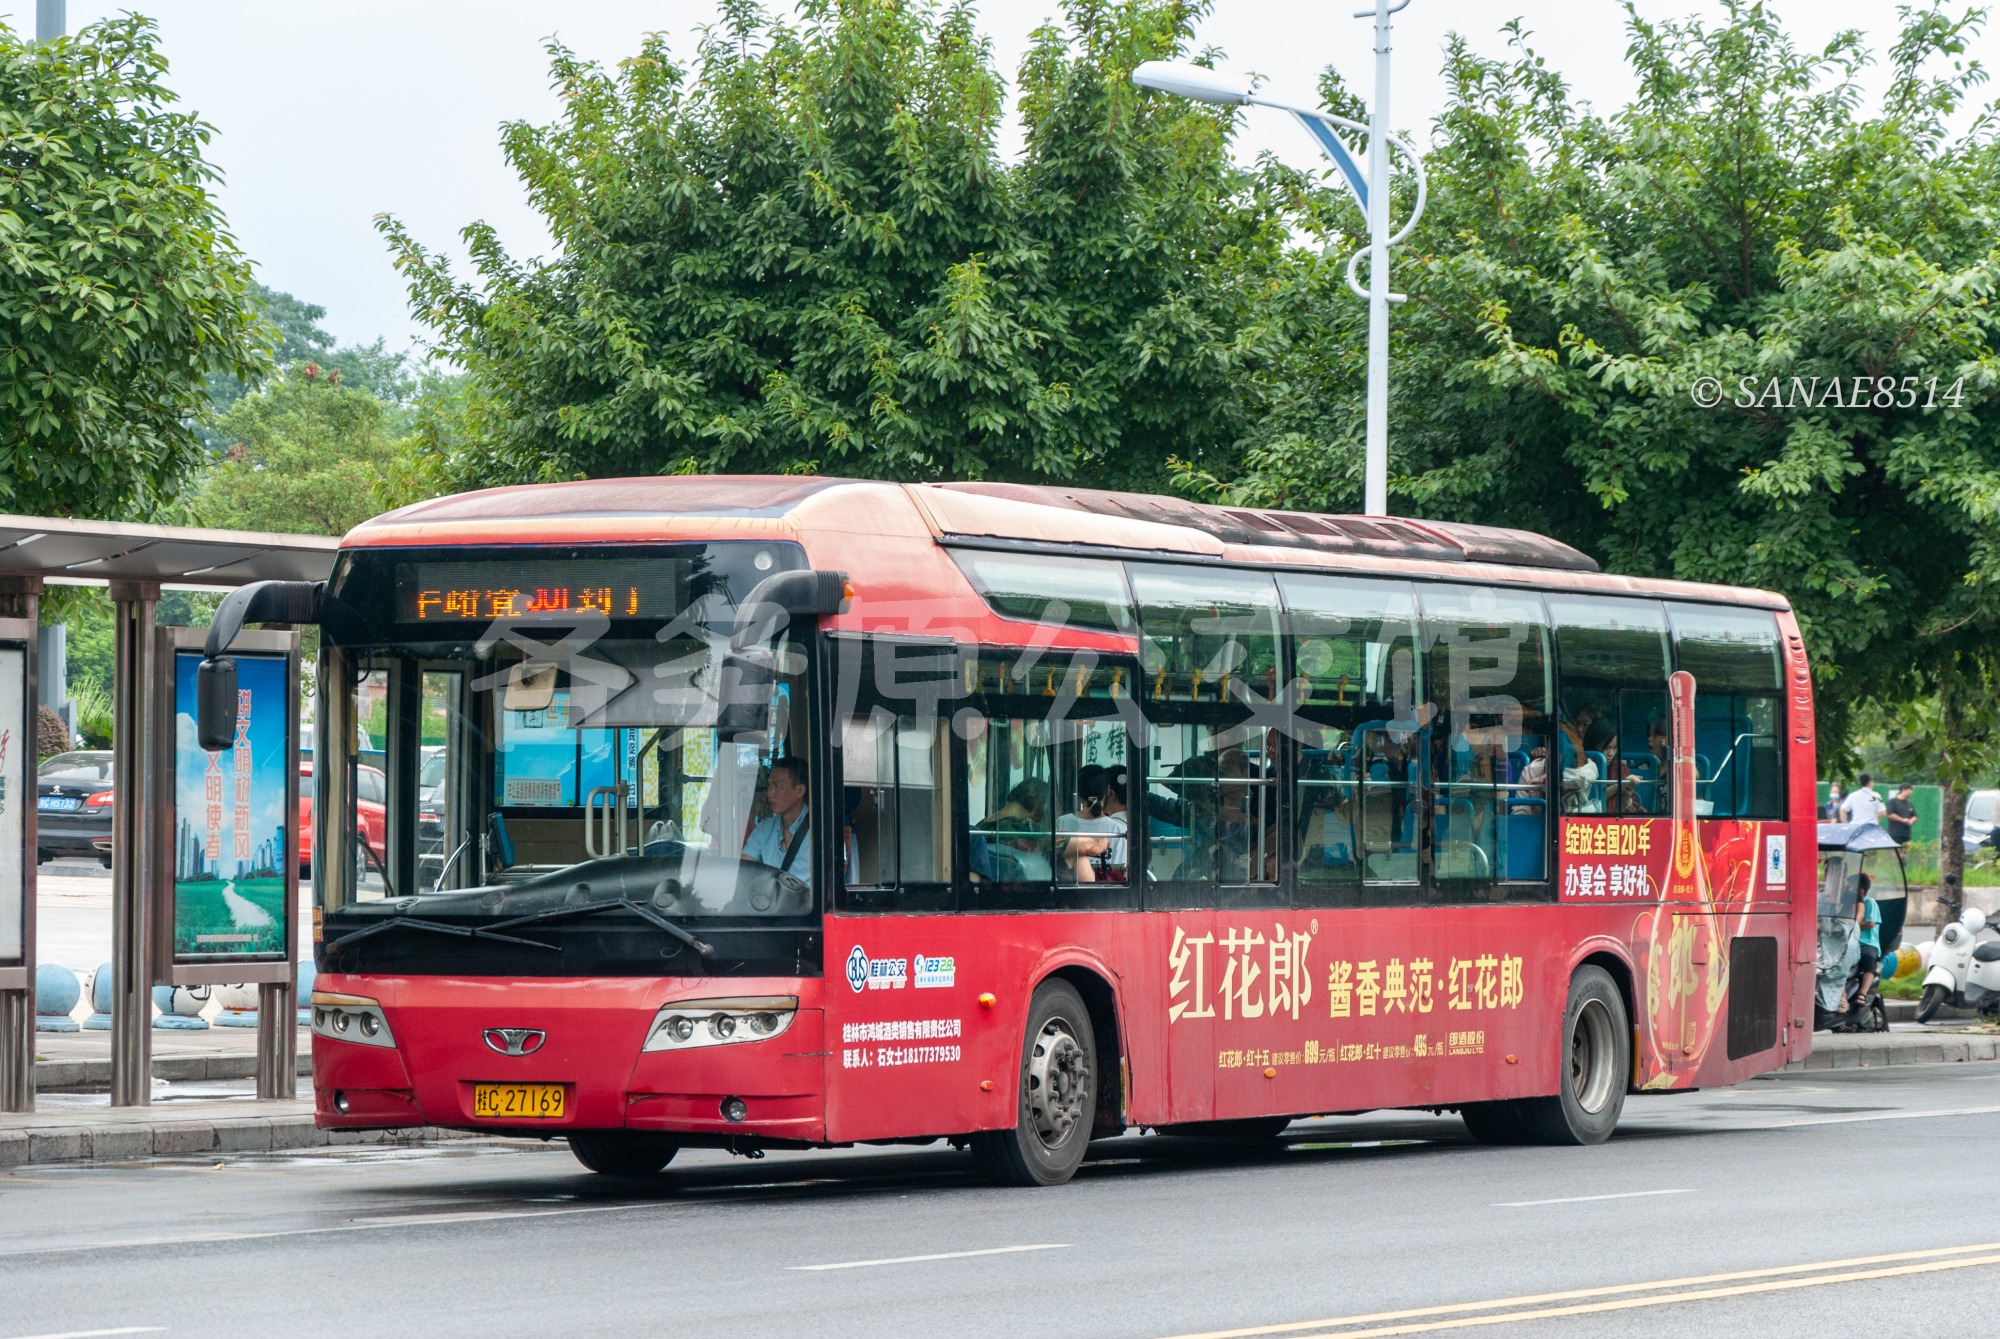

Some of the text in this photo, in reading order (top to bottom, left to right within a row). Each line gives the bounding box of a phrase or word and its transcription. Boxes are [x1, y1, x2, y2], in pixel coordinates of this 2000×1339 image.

[1566, 823, 1651, 856] 绽放全国20年
[1565, 864, 1650, 896] 办宴会 享好礼
[869, 960, 906, 978] 桂林公交
[924, 959, 954, 973] 12328
[1328, 953, 1524, 1018] 酱香典范·红花郎
